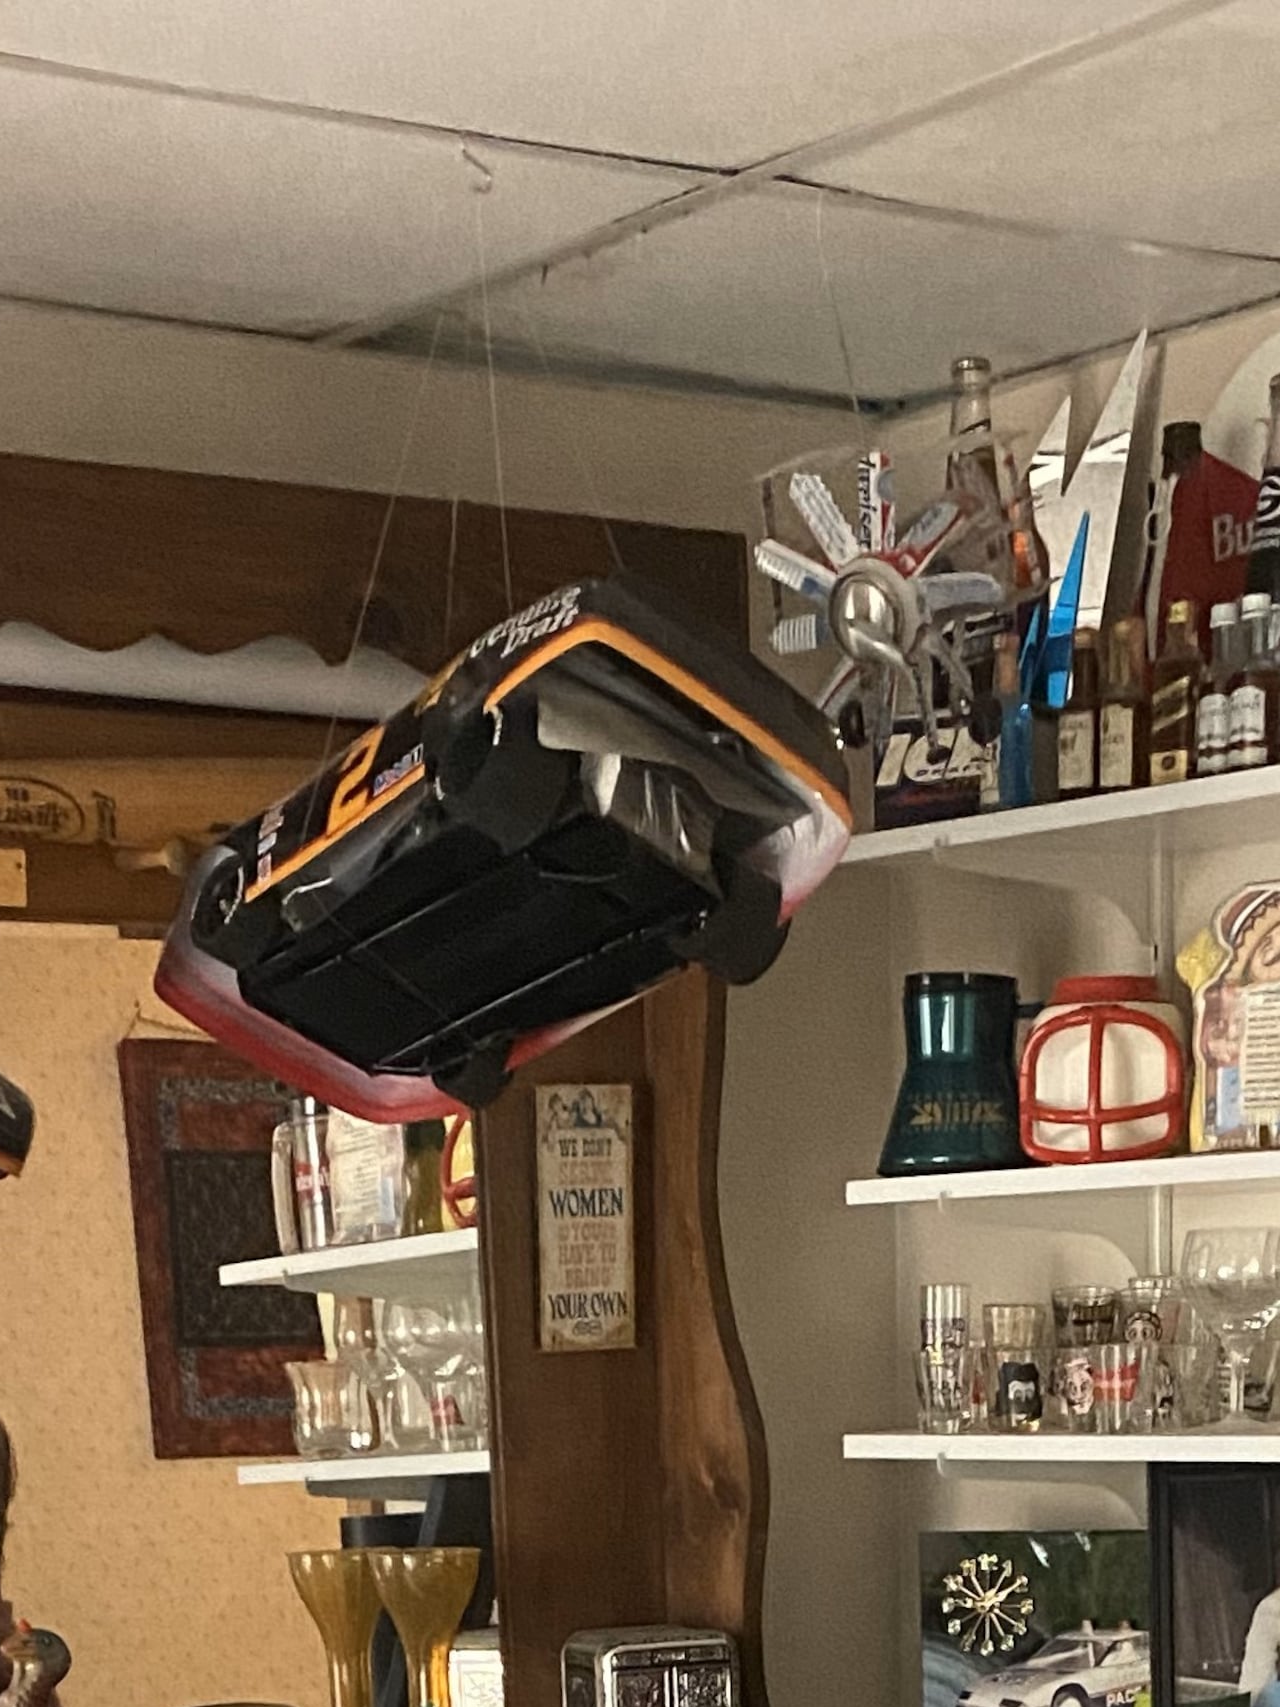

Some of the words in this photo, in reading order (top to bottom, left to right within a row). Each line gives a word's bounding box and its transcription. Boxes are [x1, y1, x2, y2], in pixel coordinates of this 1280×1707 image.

[500, 606, 579, 659] Draft
[558, 1137, 578, 1158] WE
[548, 1187, 624, 1219] WOMEN
[599, 1243, 617, 1264] TO
[547, 1293, 590, 1321] YOUR
[590, 1291, 628, 1319] OWN
